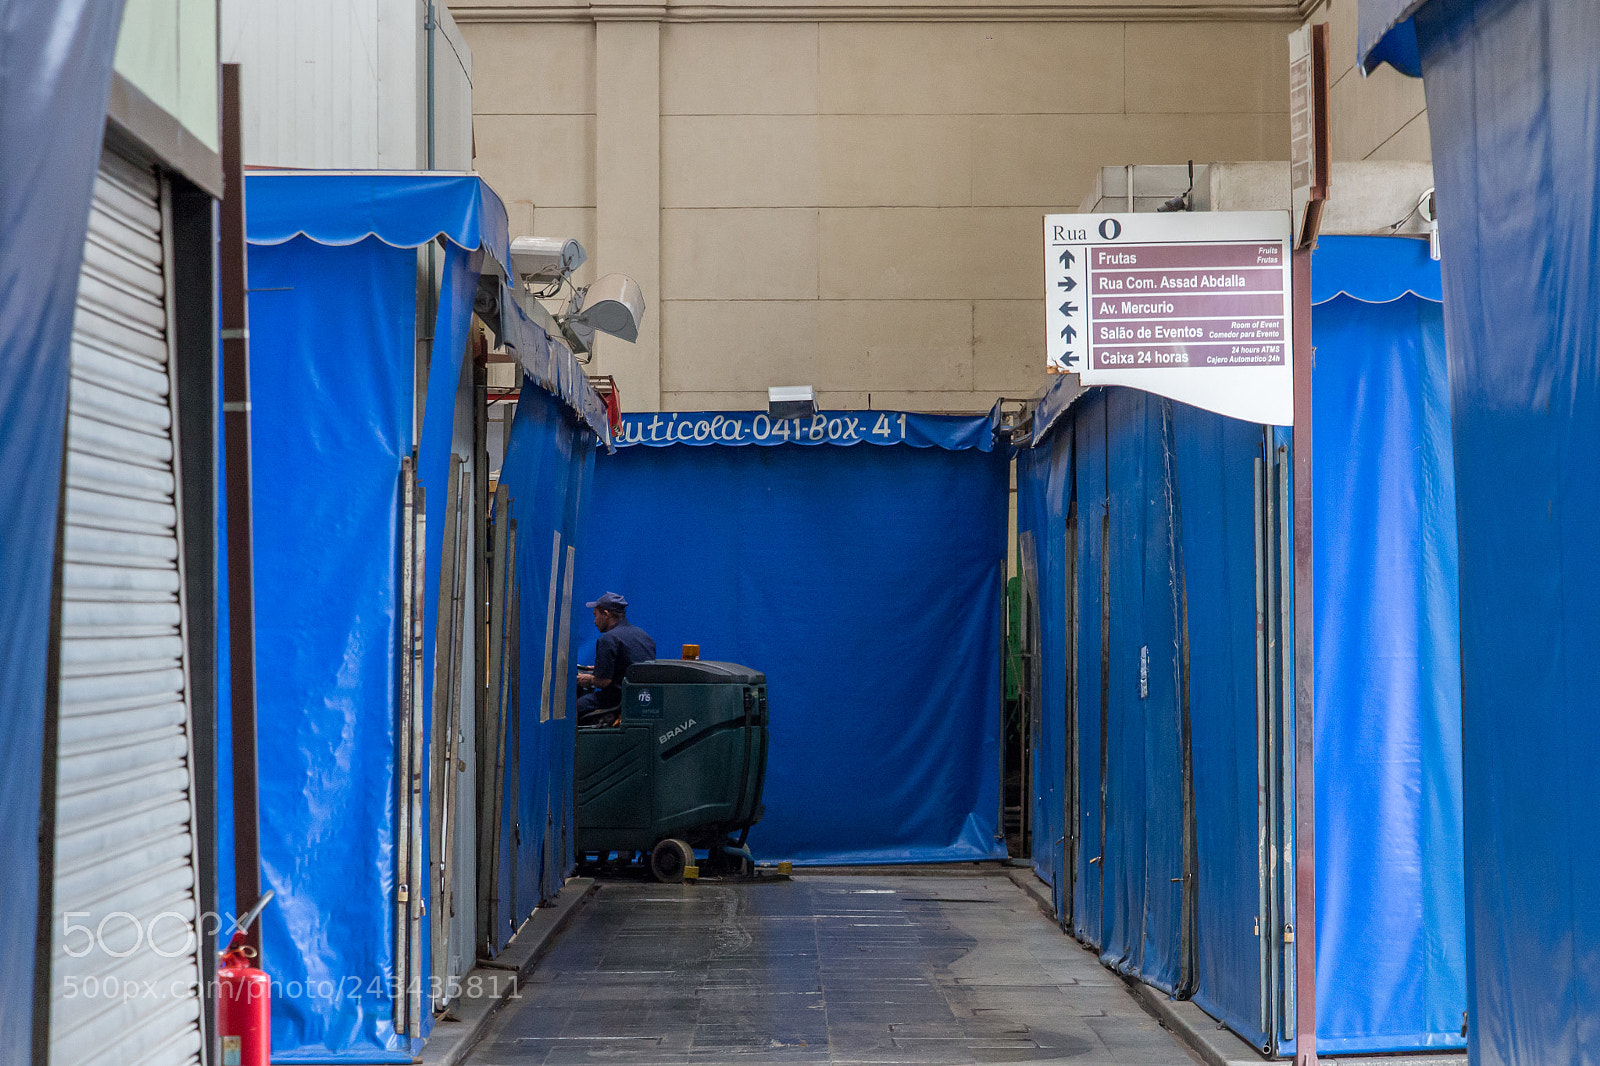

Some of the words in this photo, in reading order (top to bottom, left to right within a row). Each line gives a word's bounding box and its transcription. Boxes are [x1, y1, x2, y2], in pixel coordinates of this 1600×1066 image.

[1053, 225, 1087, 241] Rua
[1098, 218, 1122, 240] O
[1258, 247, 1278, 255] Fruits
[1098, 252, 1137, 265] Frutas
[1256, 256, 1278, 264] Frutas
[1099, 277, 1123, 290] Rua
[1126, 277, 1158, 289] Com.
[1160, 275, 1198, 288] Assad
[1200, 274, 1246, 287] Abdalla
[1099, 302, 1118, 314] Av.
[1121, 301, 1174, 314] Mercurio
[1231, 321, 1251, 329] Room
[1100, 326, 1134, 339] Salão
[1137, 326, 1152, 338] de
[1155, 326, 1204, 338] Eventos
[1240, 331, 1255, 339] para
[1100, 352, 1135, 364] Caixa
[1137, 351, 1152, 364] 24
[1155, 350, 1189, 362] horas
[658, 718, 697, 744] BRAVA
